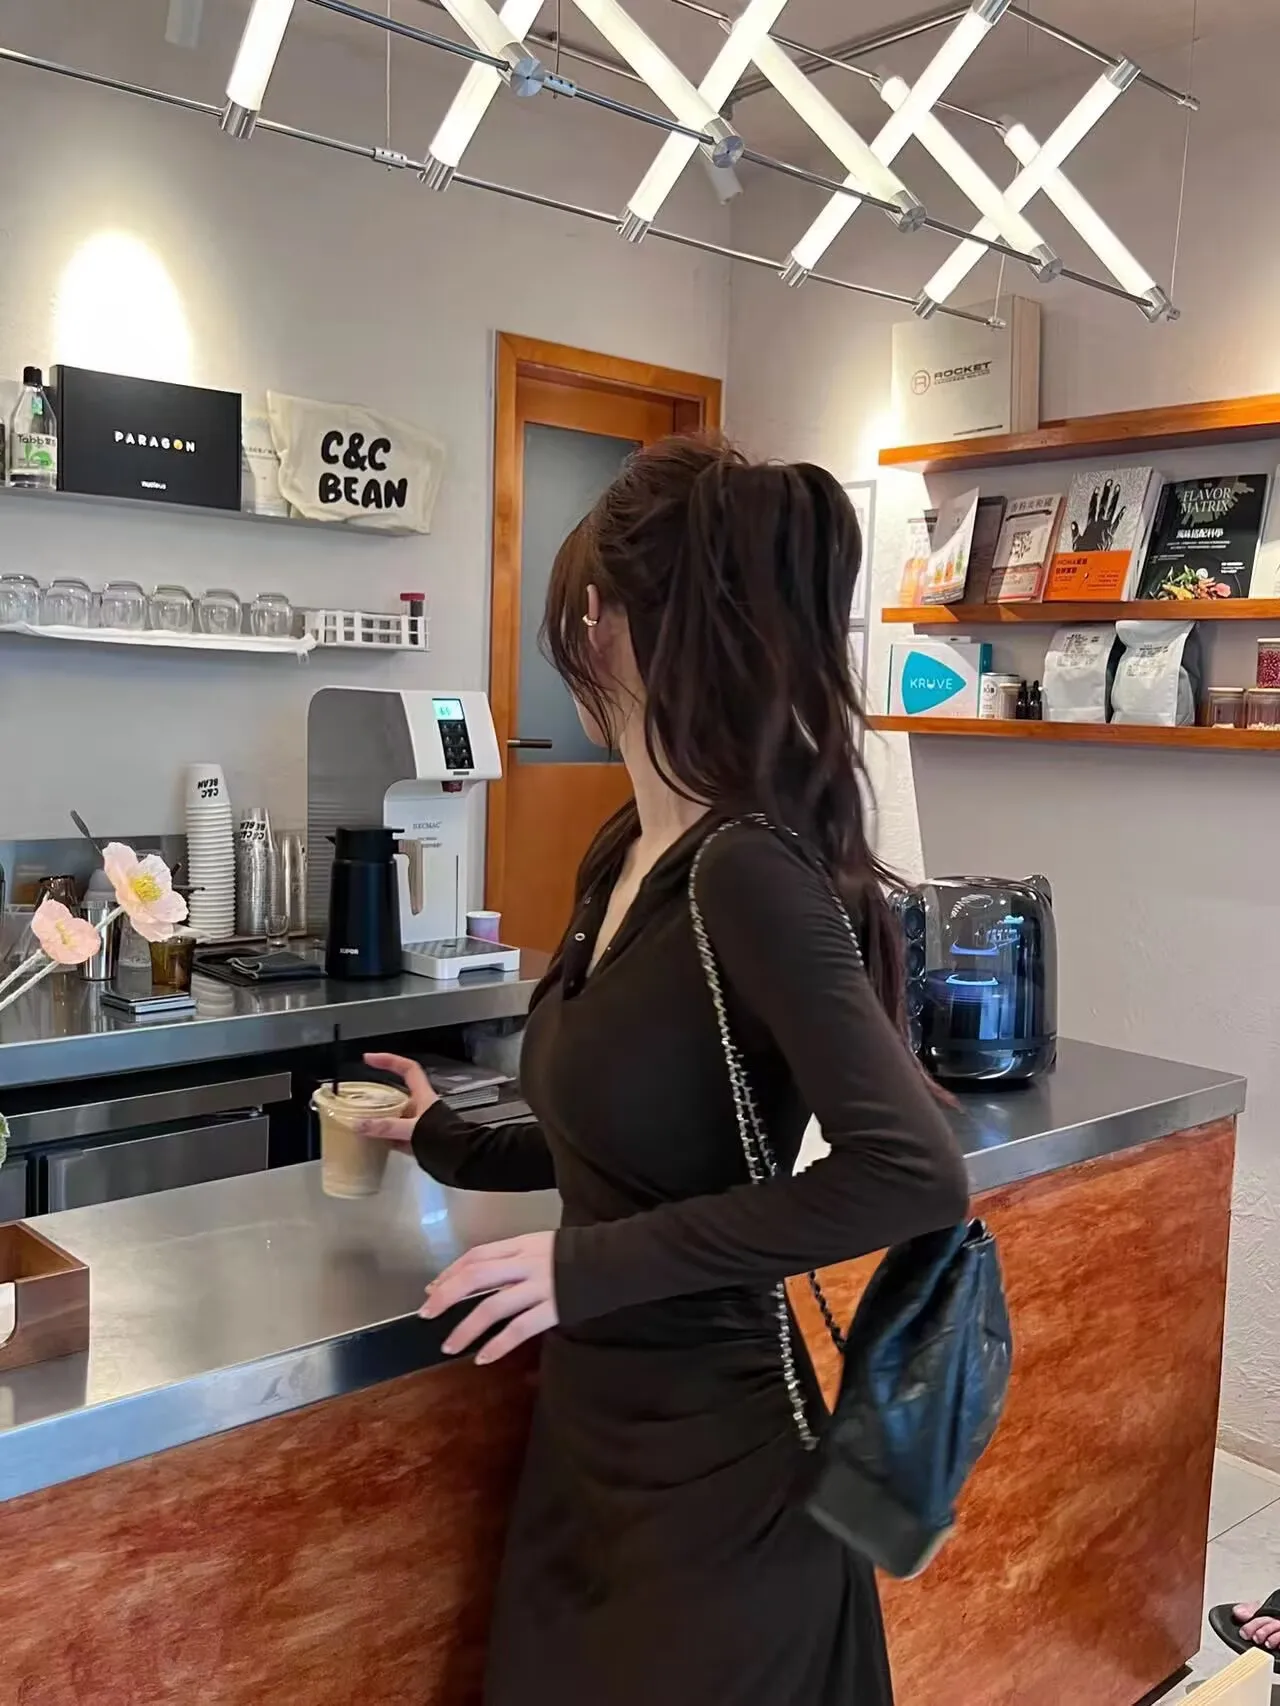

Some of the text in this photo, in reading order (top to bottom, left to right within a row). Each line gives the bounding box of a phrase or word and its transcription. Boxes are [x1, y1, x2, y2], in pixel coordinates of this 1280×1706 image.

[934, 360, 992, 380] ROCKET
[114, 430, 196, 453] PARAGON
[321, 430, 391, 472] C&C
[318, 472, 408, 509] BEAN
[1183, 487, 1232, 502] FLAVOR
[1180, 499, 1229, 514] MATRIX
[910, 677, 953, 690] KRUVE
[197, 778, 219, 789] BEAN
[201, 788, 219, 798] C&C
